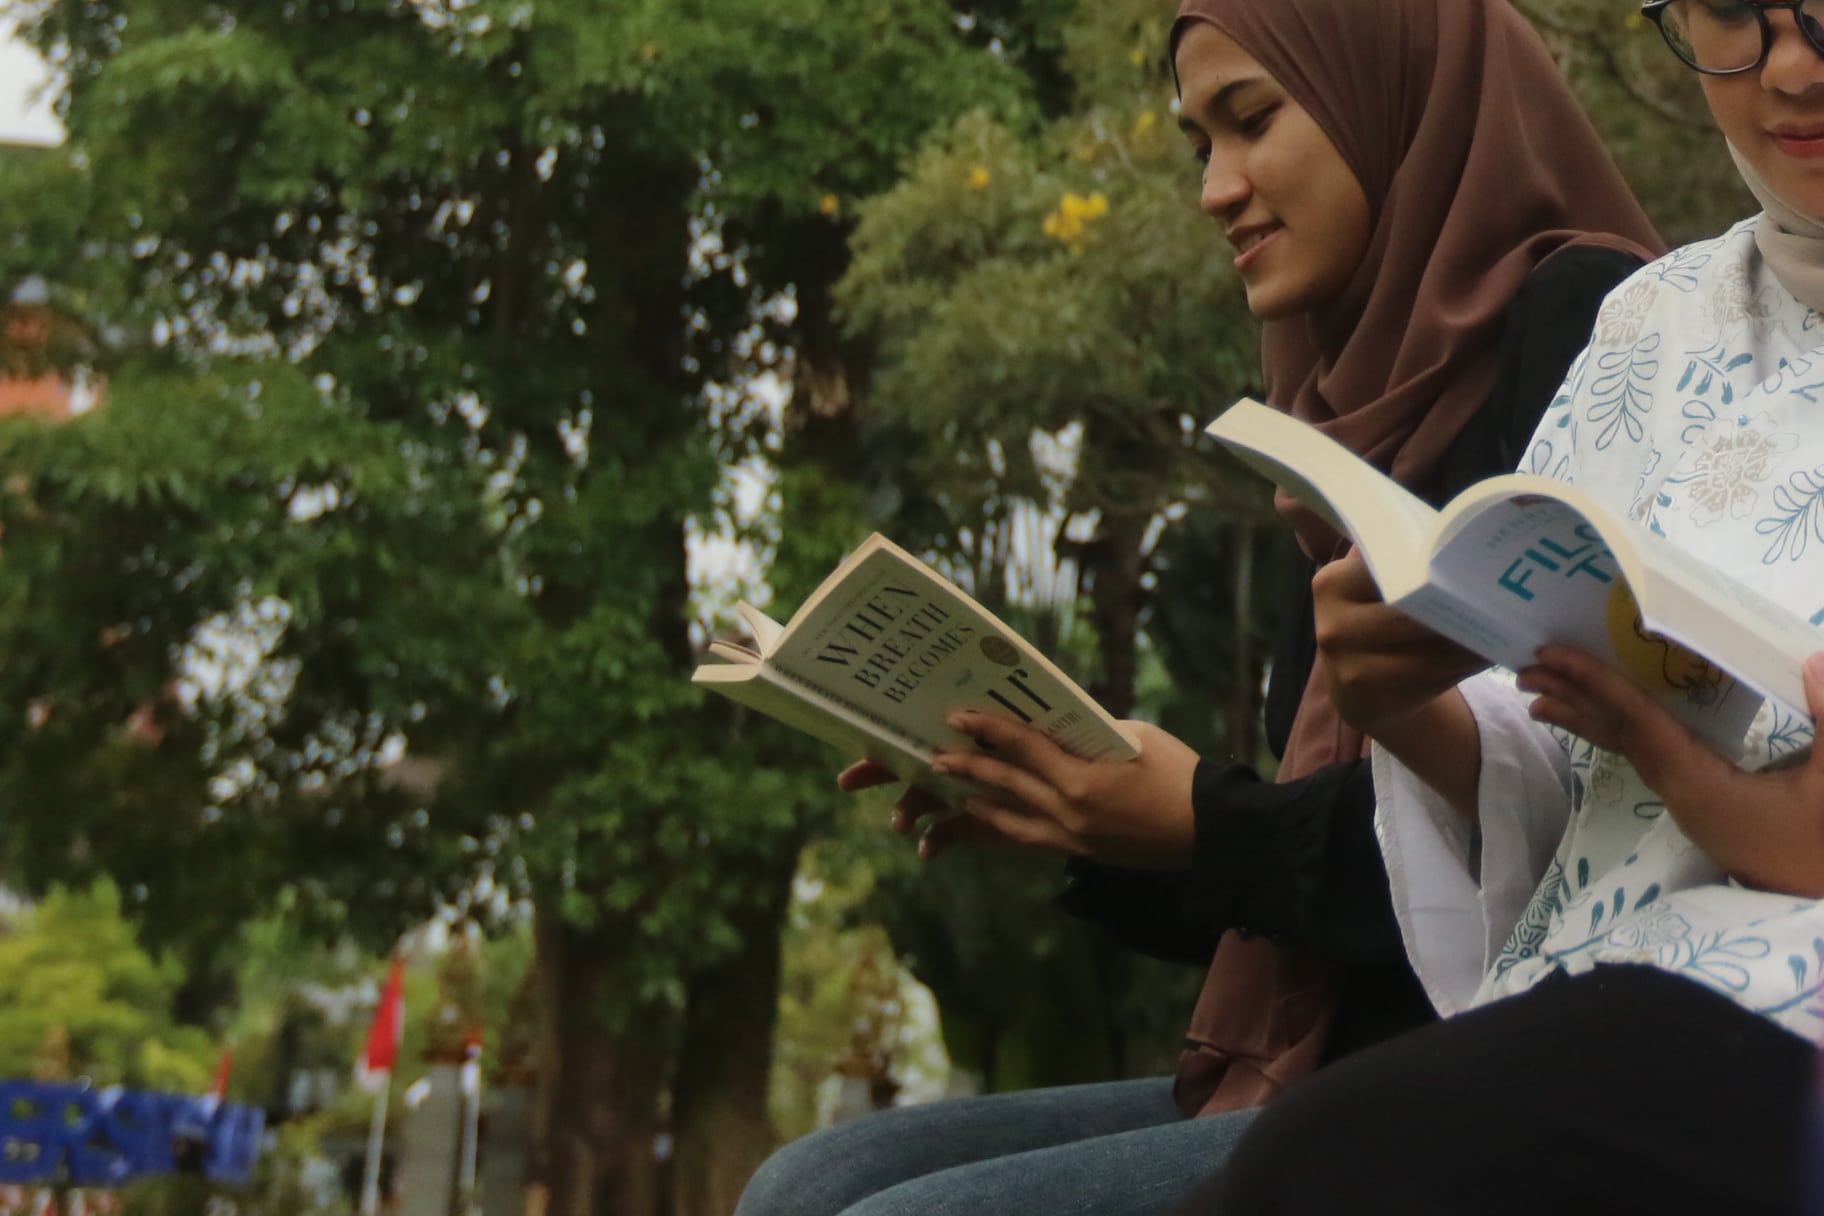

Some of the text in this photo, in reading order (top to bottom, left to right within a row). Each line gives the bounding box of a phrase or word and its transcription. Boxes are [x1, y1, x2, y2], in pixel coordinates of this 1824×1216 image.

[816, 586, 919, 666] WHEN
[854, 602, 949, 688] BREATH
[883, 625, 975, 703] BECOMES
